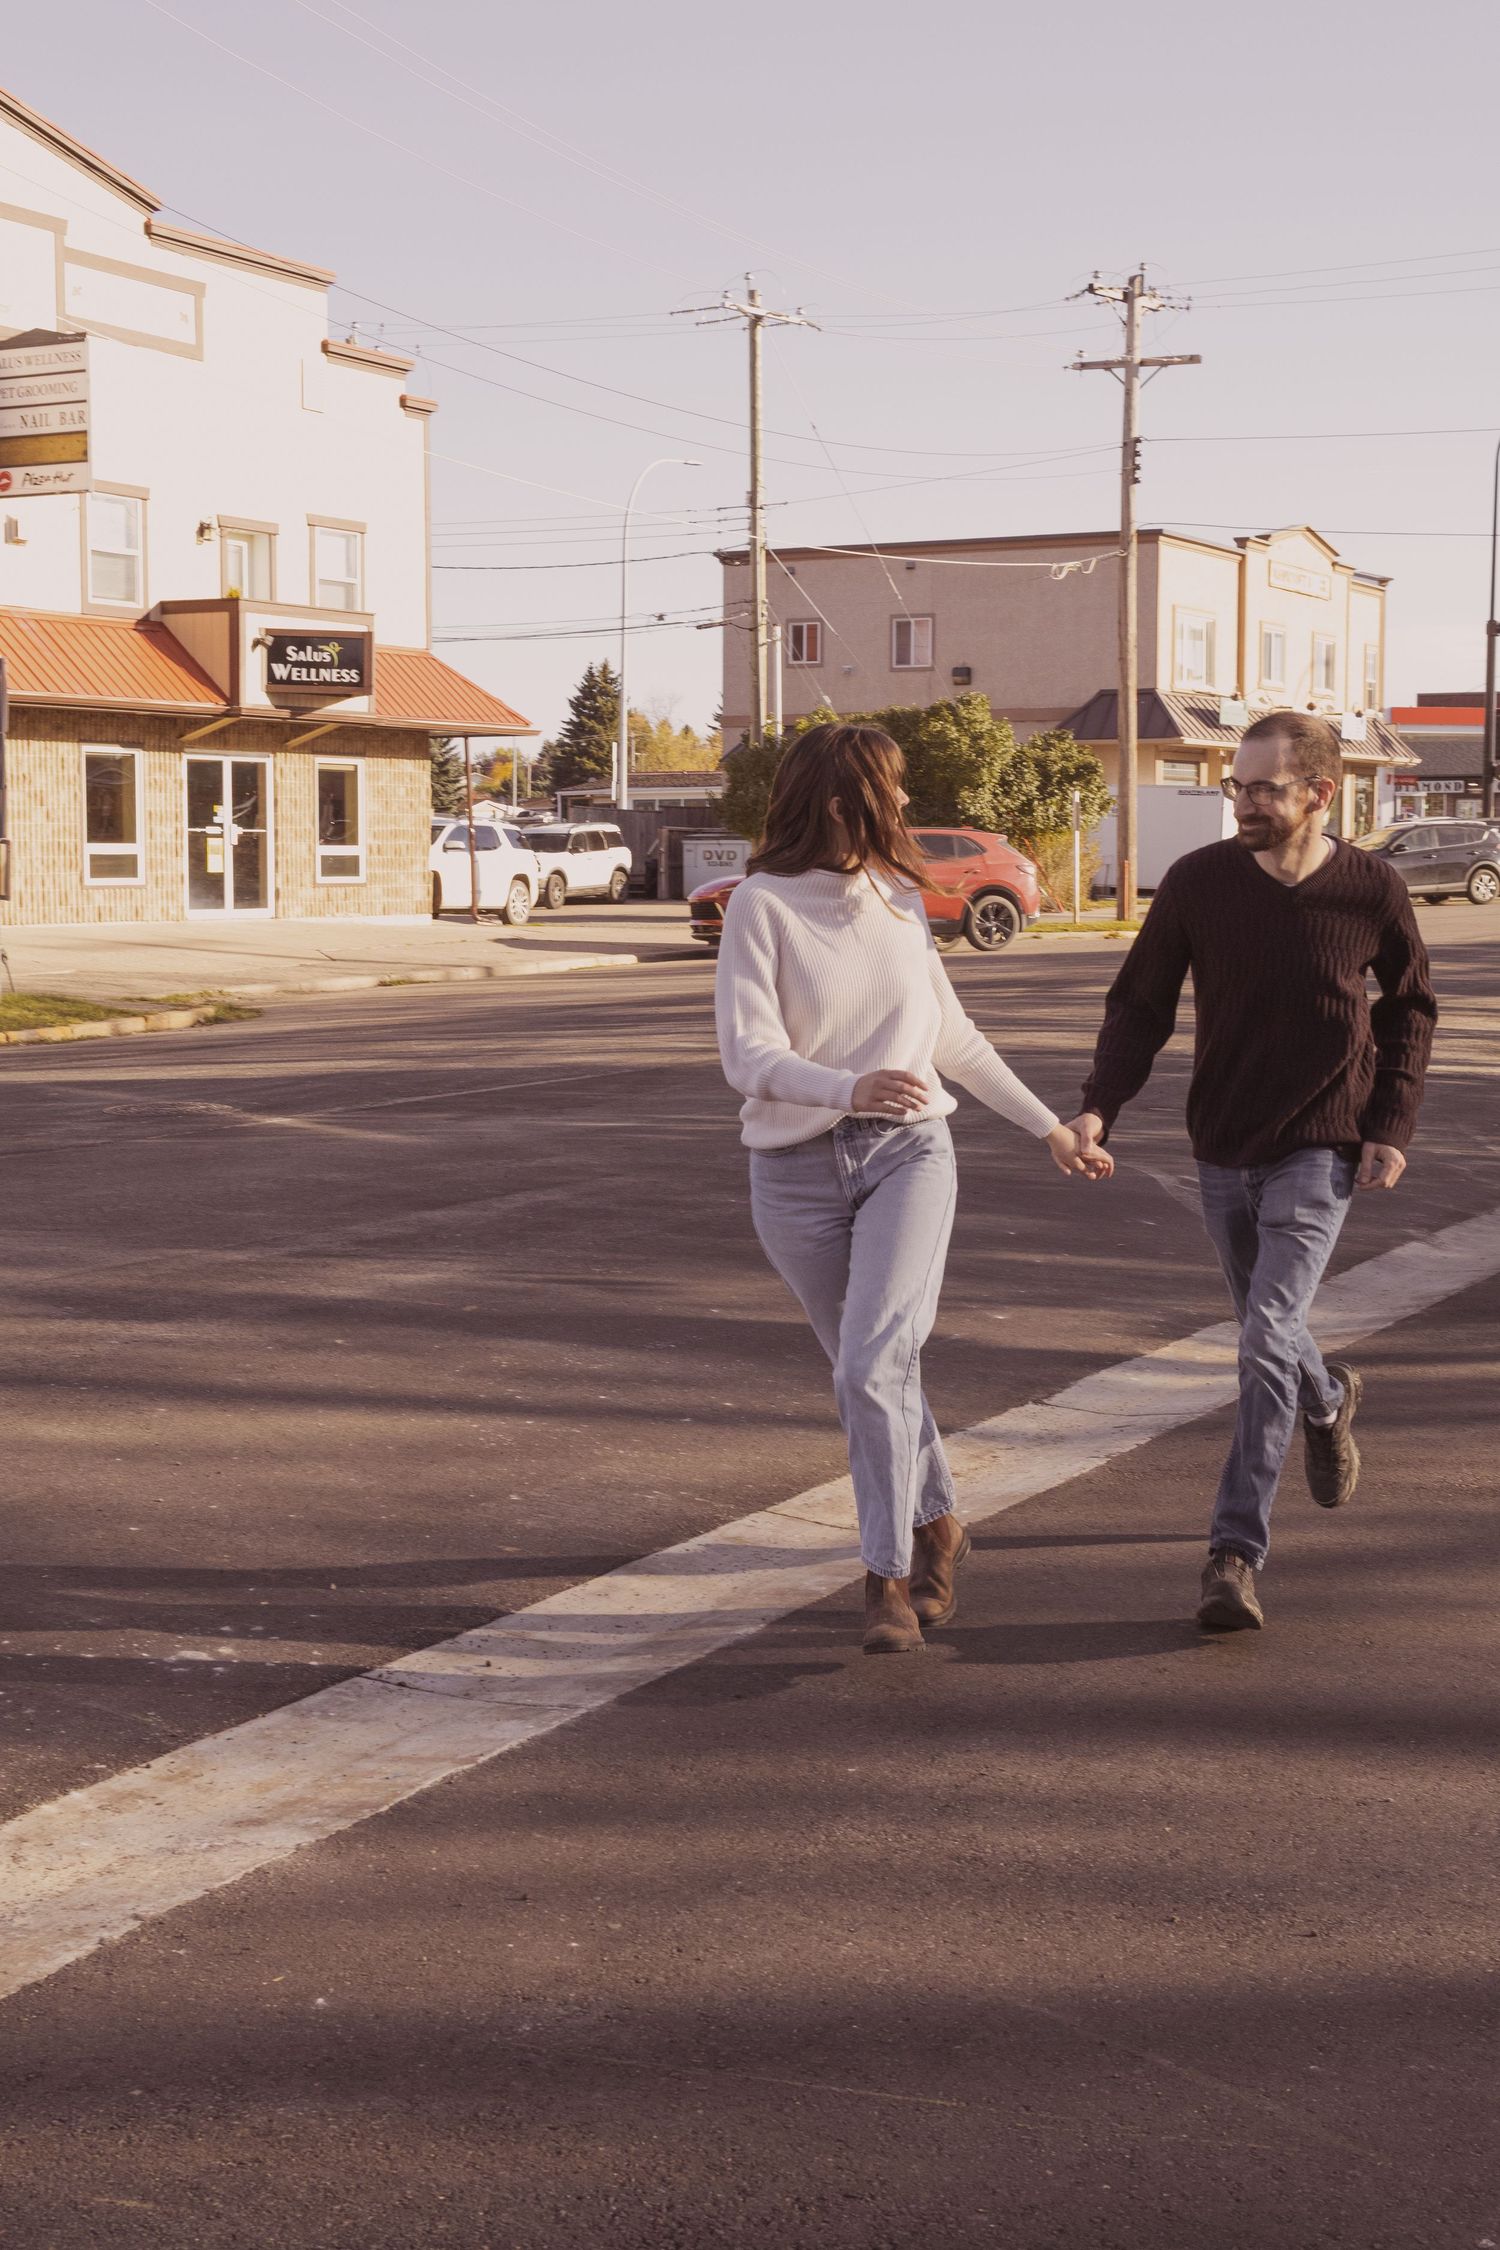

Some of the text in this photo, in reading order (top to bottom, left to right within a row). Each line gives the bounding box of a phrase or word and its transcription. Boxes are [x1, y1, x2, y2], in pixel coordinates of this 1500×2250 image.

[24, 351, 81, 366] WELLNESS
[17, 382, 78, 398] GROOMING
[20, 413, 51, 429] NAIL
[59, 410, 86, 426] BAR
[270, 663, 360, 682] WELLNESS
[1395, 781, 1463, 792] DIAMOND
[703, 849, 737, 861] DVD
